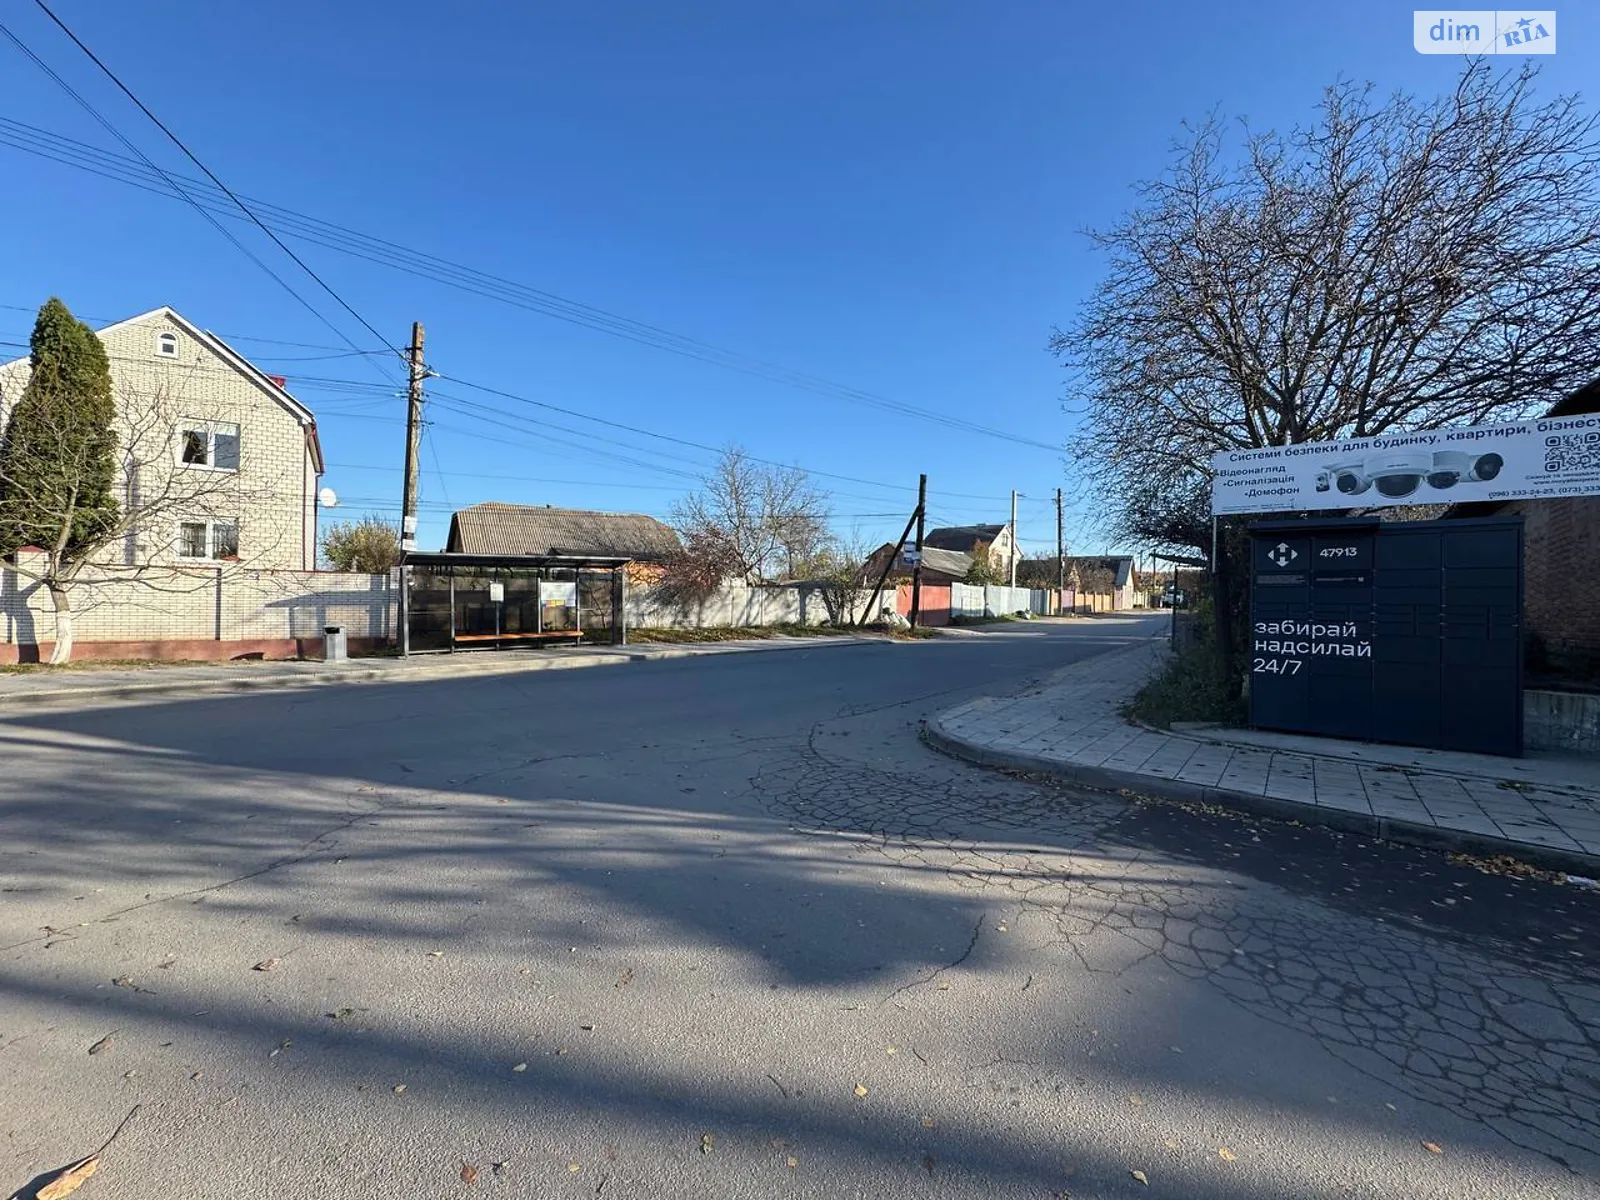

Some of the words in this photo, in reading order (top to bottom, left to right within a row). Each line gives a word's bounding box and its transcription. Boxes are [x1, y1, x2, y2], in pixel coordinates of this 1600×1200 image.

[1229, 451, 1281, 462] Системи
[1285, 443, 1338, 457] безпеки
[1342, 442, 1369, 452] для
[1373, 434, 1441, 449] будинку,
[1446, 426, 1531, 441] квартири,
[1320, 547, 1357, 557] 47913
[1254, 620, 1357, 639] забирай
[1254, 640, 1371, 657] надсилай
[1253, 658, 1302, 675] 24/7
